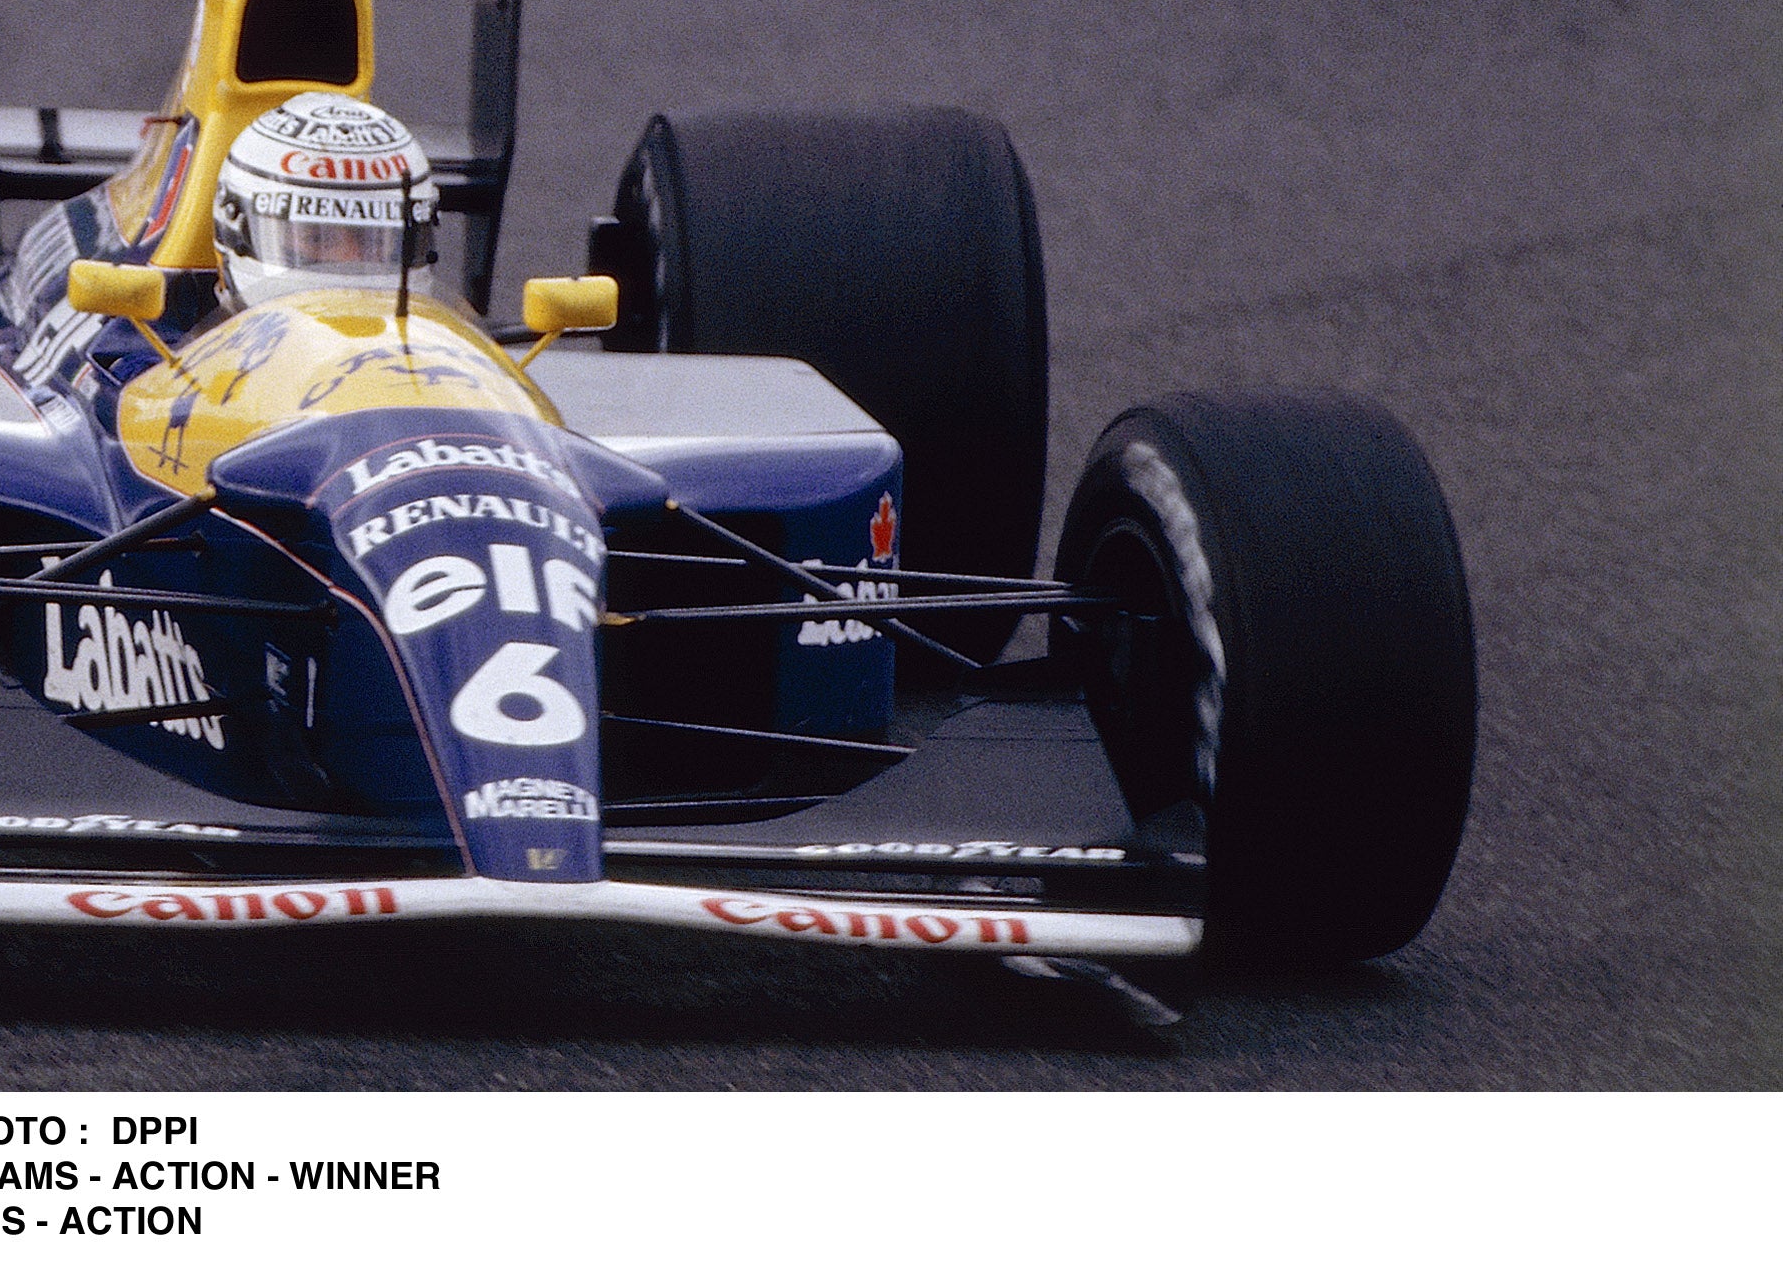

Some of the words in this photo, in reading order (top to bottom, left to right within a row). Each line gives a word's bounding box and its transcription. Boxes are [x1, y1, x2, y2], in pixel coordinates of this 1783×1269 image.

[281, 150, 410, 181] Canon
[347, 494, 607, 567] RENAULT
[451, 642, 587, 746] 6
[66, 887, 400, 921] Canon
[701, 897, 1029, 945] Canon
